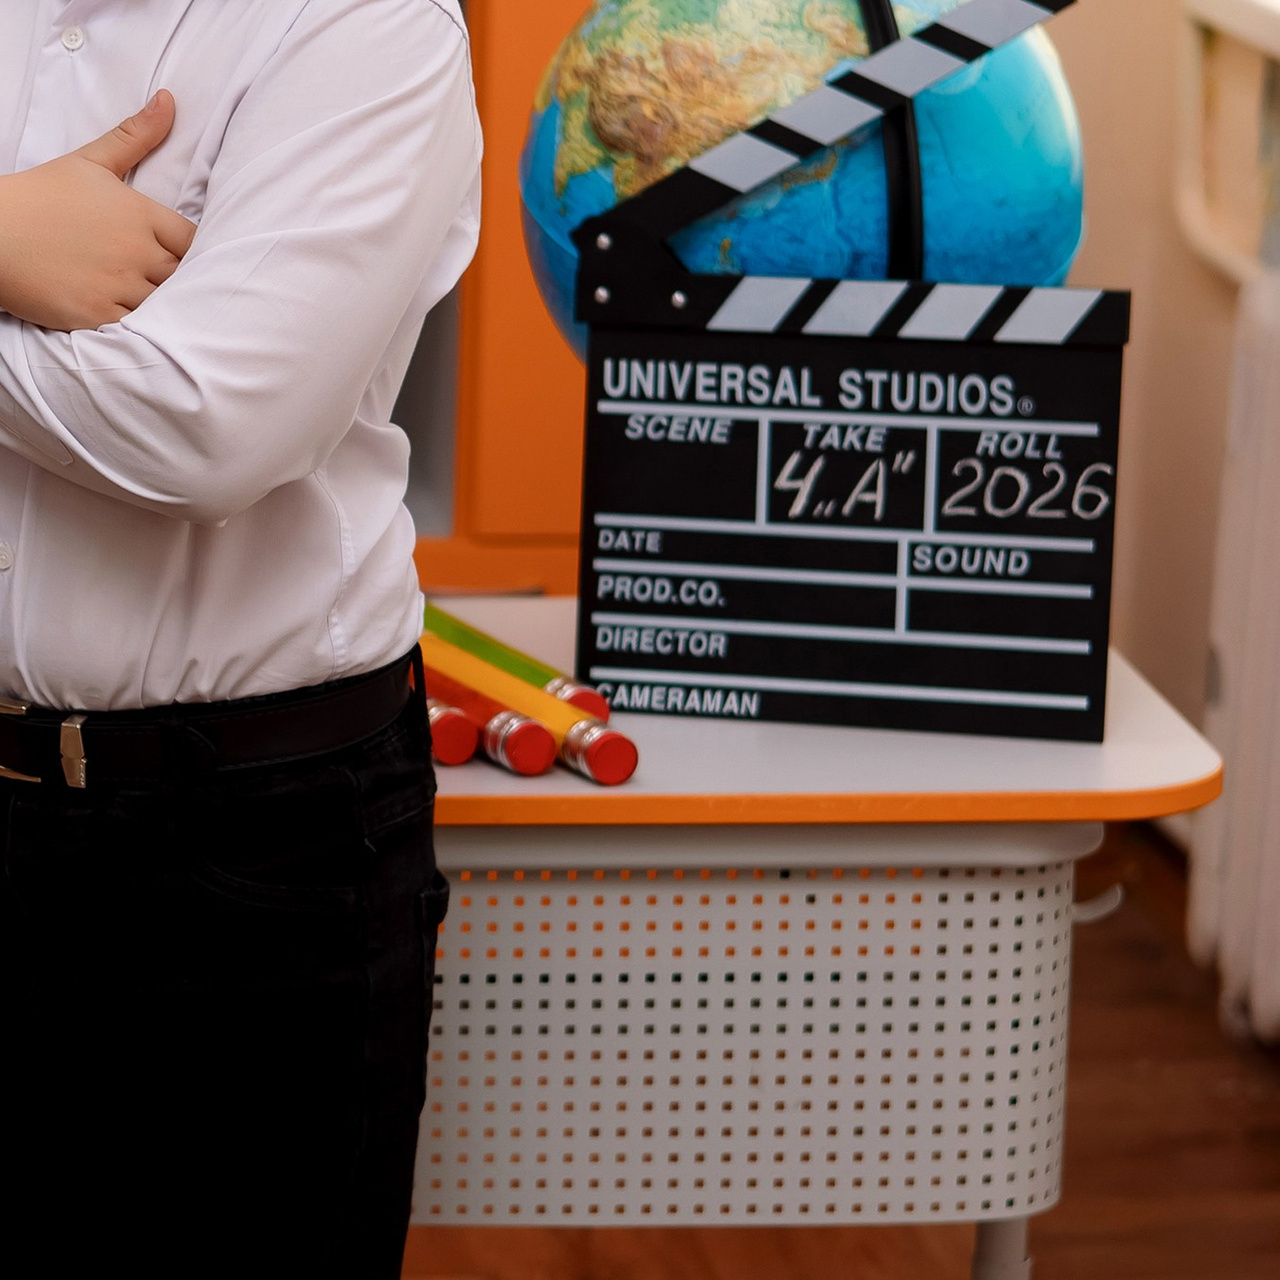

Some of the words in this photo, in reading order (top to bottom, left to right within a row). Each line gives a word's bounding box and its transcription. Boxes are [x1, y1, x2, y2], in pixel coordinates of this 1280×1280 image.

[602, 357, 822, 408] UNIVERSAL
[624, 414, 734, 445] SCENE
[802, 423, 889, 453] TAKE
[975, 431, 1064, 460] ROLL
[941, 457, 1114, 520] 2026
[598, 528, 662, 554] DATE
[912, 545, 1031, 577] SOUND
[596, 626, 728, 658] DIRECTOR
[597, 682, 761, 718] CAMERAMAN
